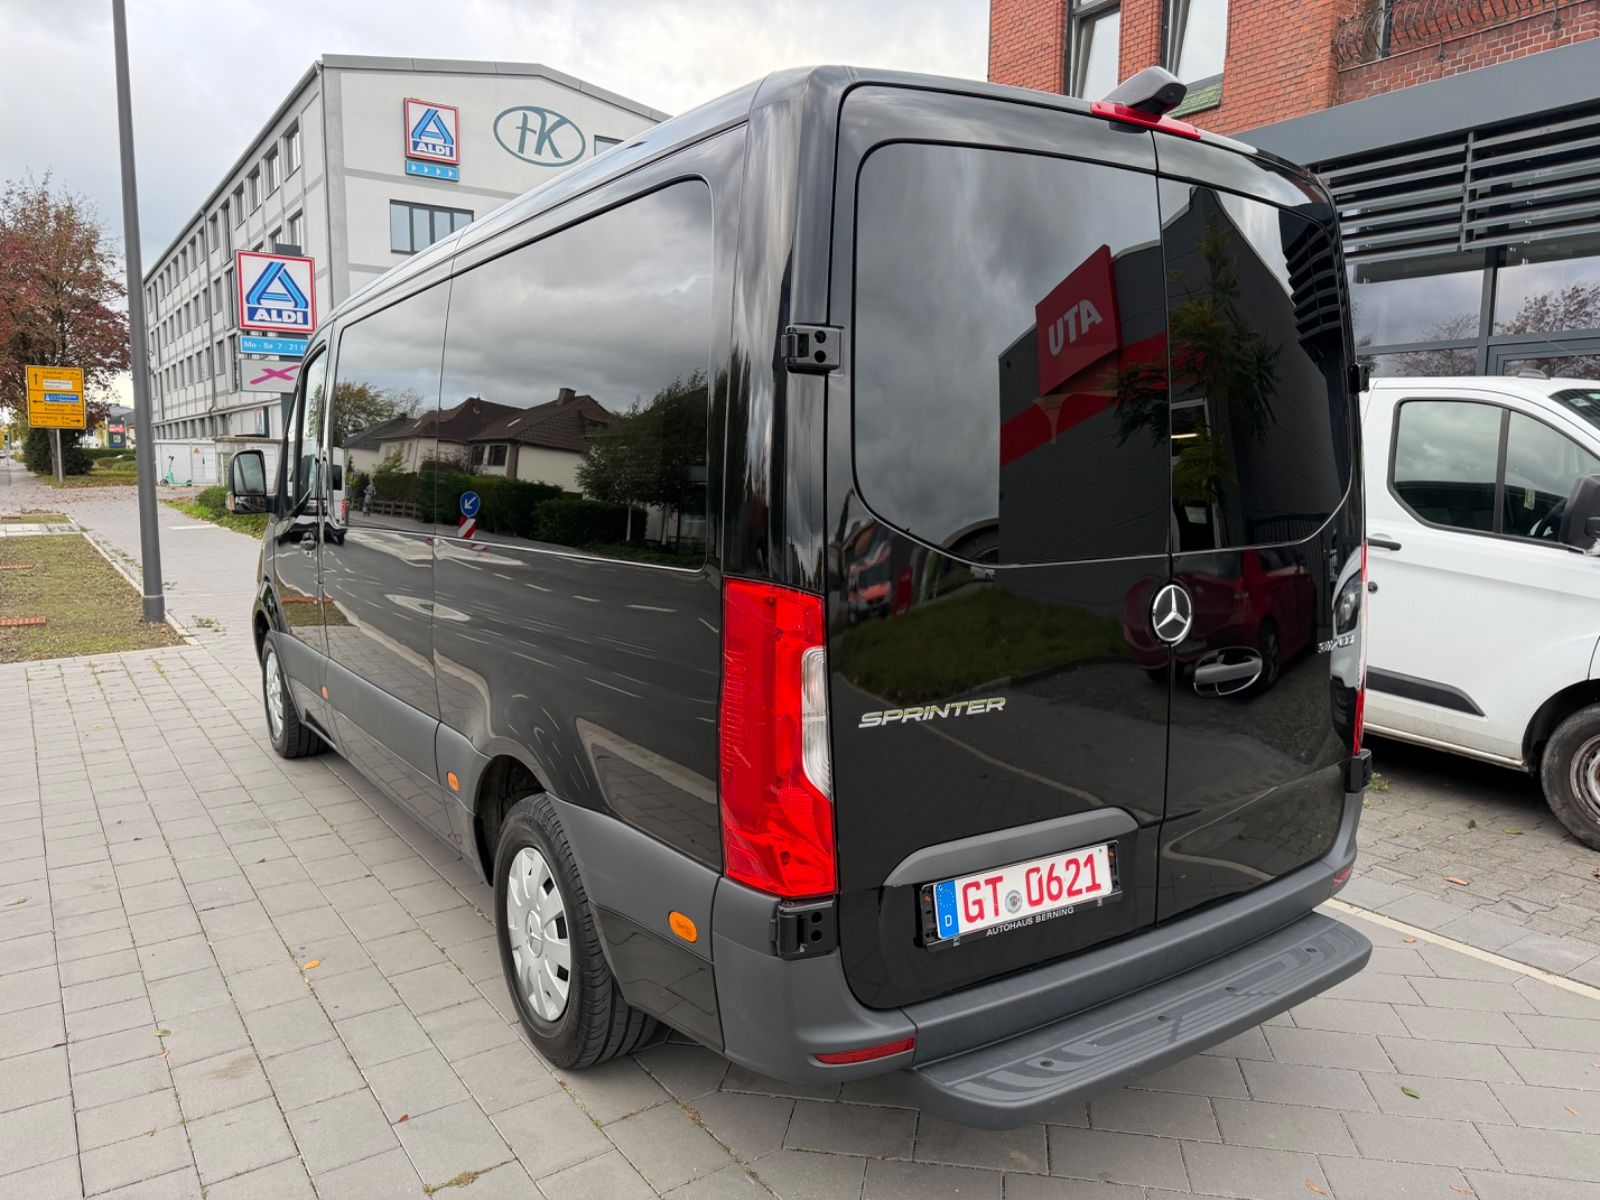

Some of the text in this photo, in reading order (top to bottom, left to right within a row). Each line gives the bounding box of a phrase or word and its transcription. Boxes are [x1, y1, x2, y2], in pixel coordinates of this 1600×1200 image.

[416, 141, 450, 156] ALDI
[253, 308, 304, 324] ALDI
[243, 341, 257, 349] Mo
[263, 341, 273, 349] Sa
[288, 343, 298, 351] 21
[858, 697, 1006, 728] SPRINTER
[962, 853, 1102, 923] GT 0621
[944, 914, 952, 927] D
[986, 906, 1074, 937] AUTOHAUS BERNING
